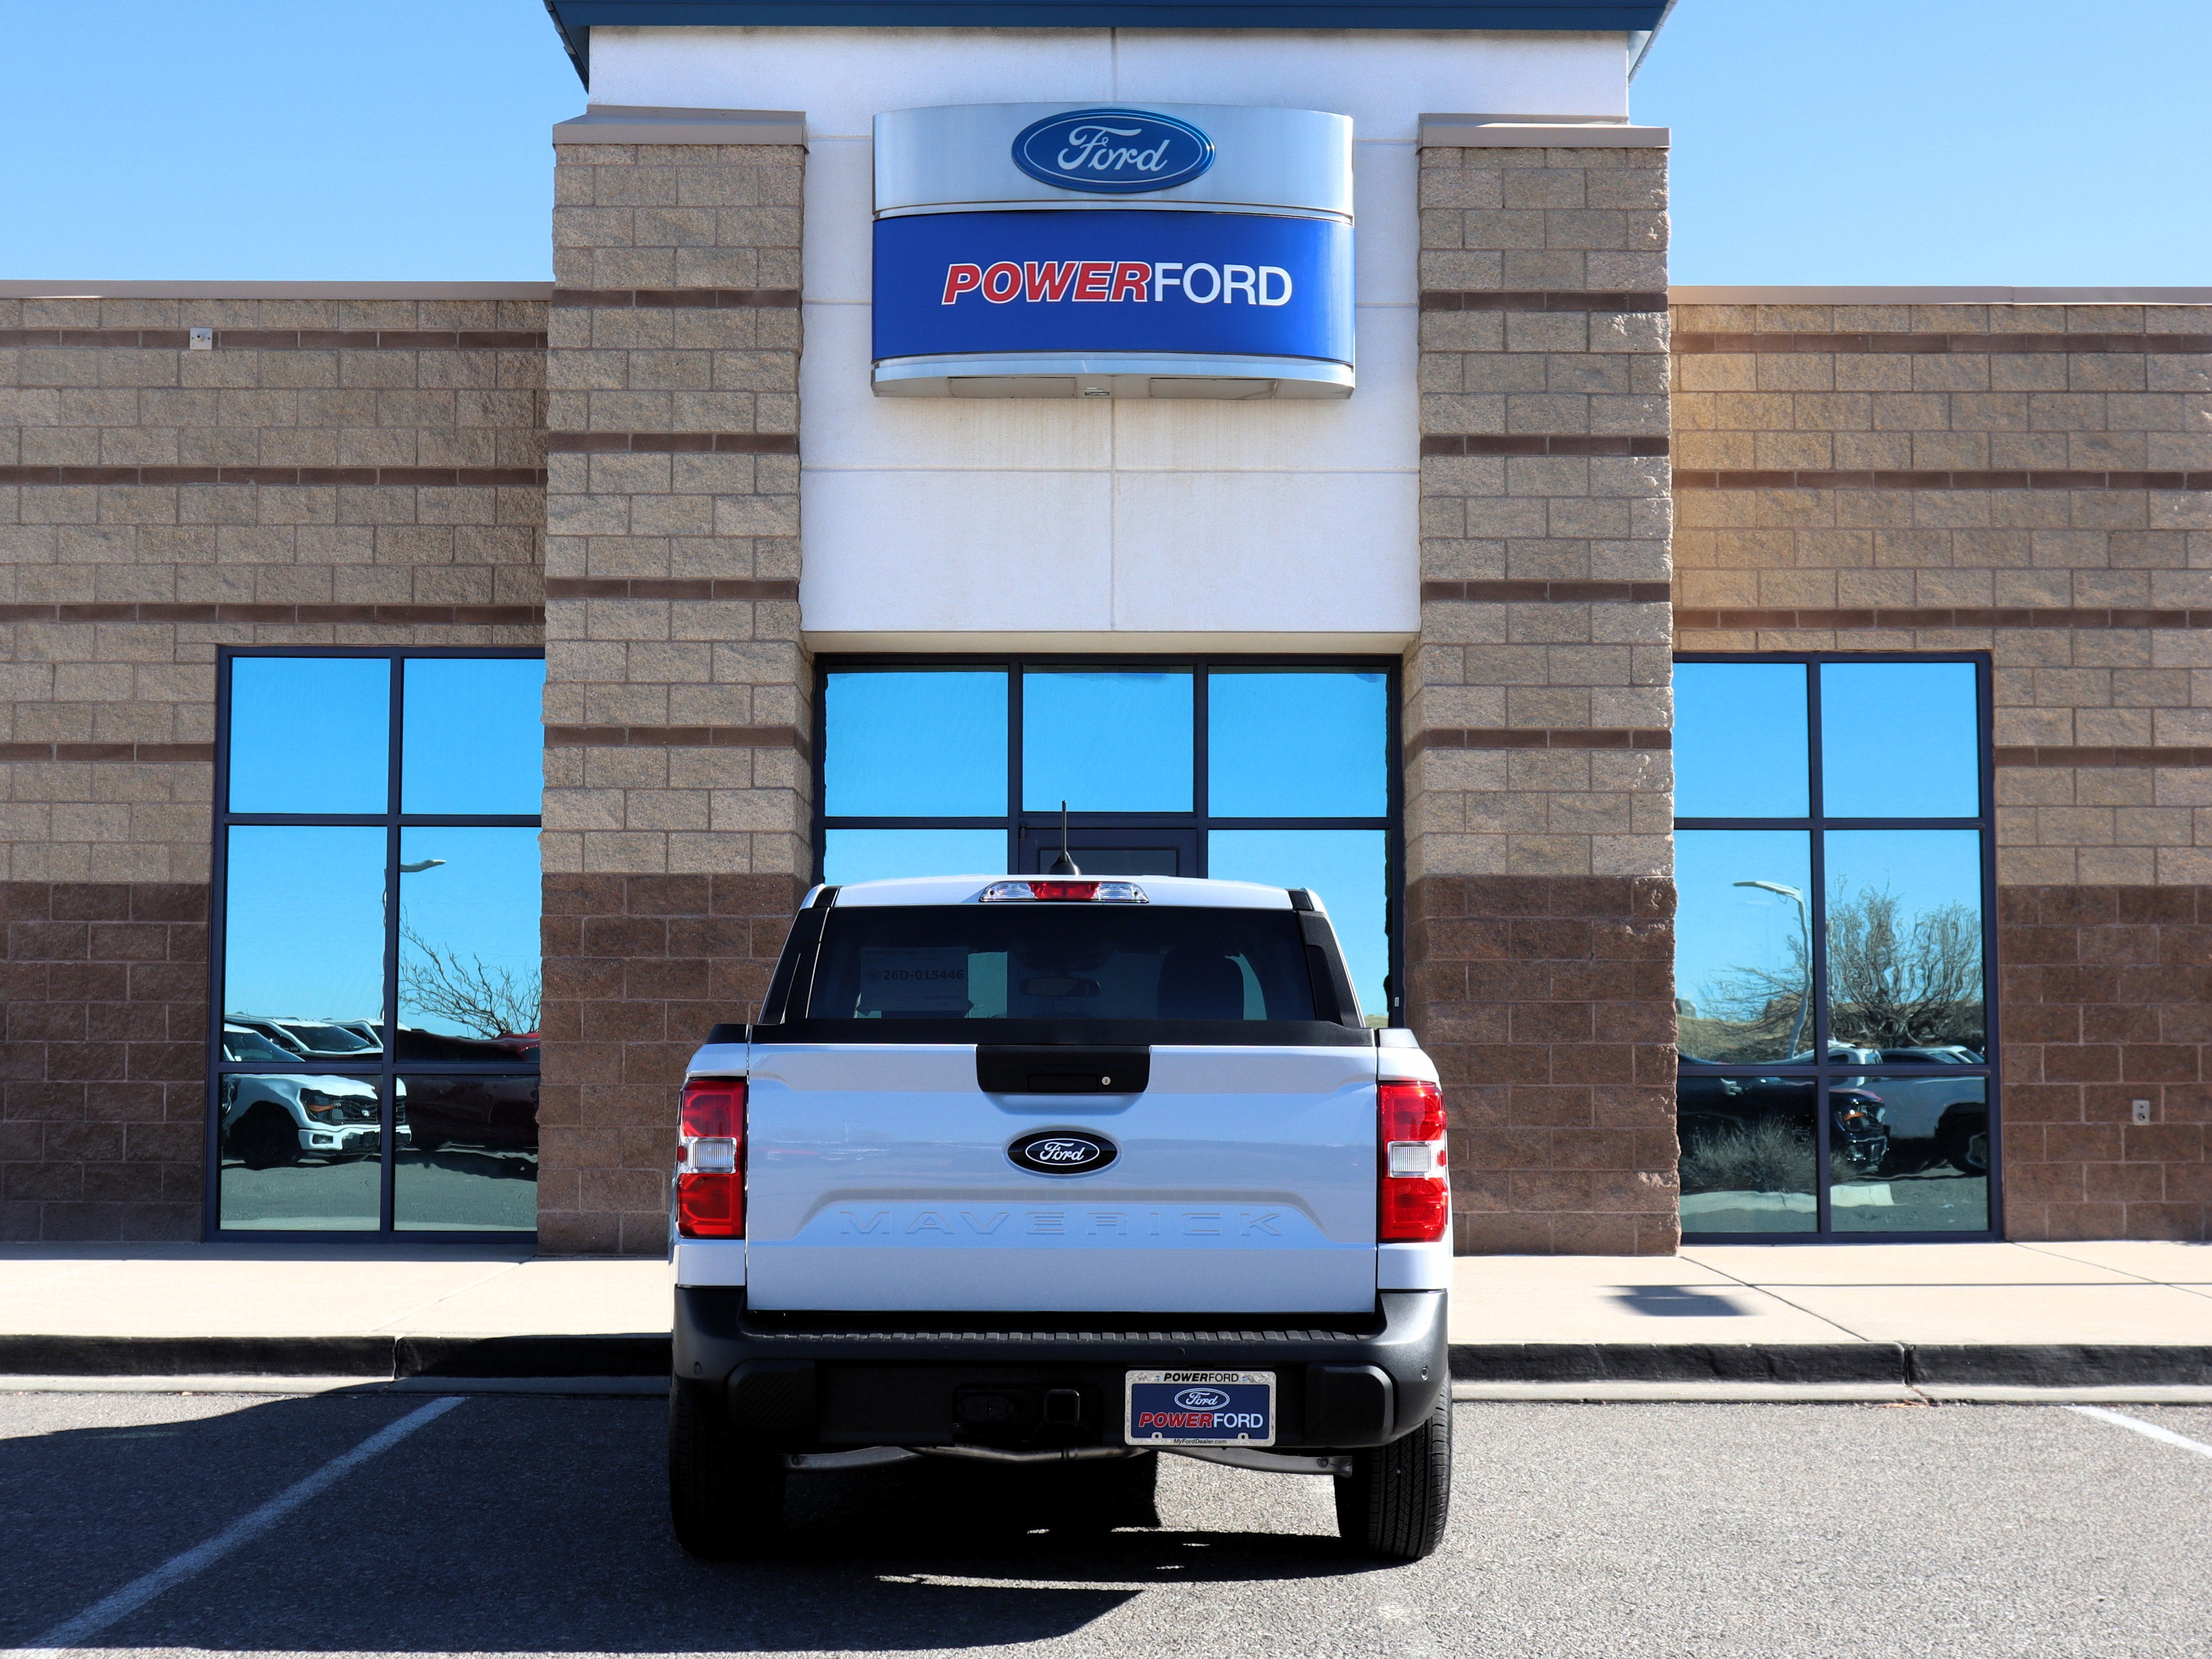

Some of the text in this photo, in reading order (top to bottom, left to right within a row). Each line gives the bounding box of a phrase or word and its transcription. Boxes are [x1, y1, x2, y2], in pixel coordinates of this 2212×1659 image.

[1057, 125, 1170, 172] Ford
[942, 261, 1292, 306] POWERFORD
[883, 969, 964, 980] 26D-015446
[1039, 1141, 1086, 1161] Ford
[840, 1211, 1283, 1236] MAVERICK
[1163, 1373, 1239, 1382] POWERFORD
[1185, 1391, 1218, 1406] Ford
[1138, 1412, 1264, 1428] POWERFORD
